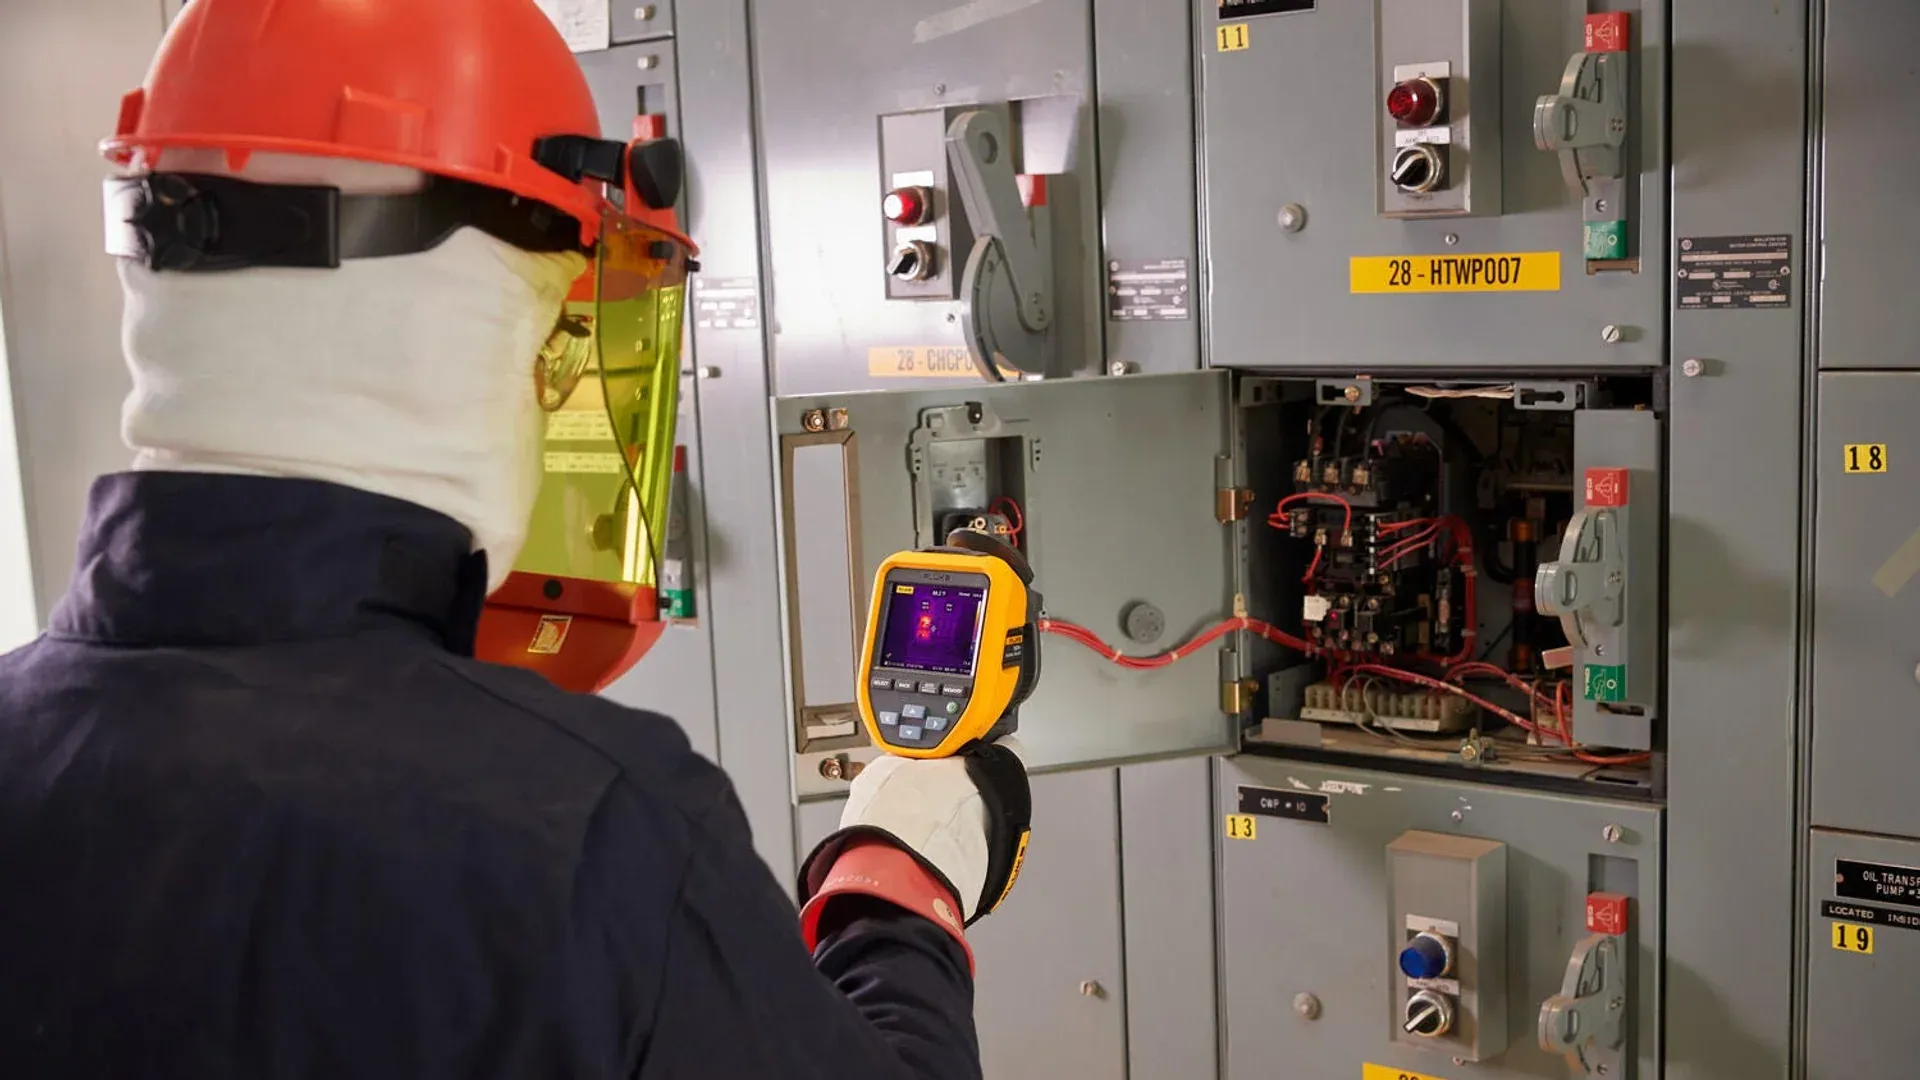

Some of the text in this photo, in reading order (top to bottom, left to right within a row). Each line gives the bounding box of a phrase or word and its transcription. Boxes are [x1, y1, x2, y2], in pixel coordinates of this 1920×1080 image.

[1220, 26, 1243, 49] 11
[1389, 259, 1412, 286] 28
[1430, 257, 1521, 285] HTWP007
[897, 349, 915, 371] 28
[1849, 445, 1882, 470] 18
[1230, 817, 1252, 837] 13
[1863, 870, 1879, 882] OIL
[1876, 883, 1905, 896] PUMP
[1828, 905, 1874, 919] LOCATED
[1837, 925, 1869, 951] 19
